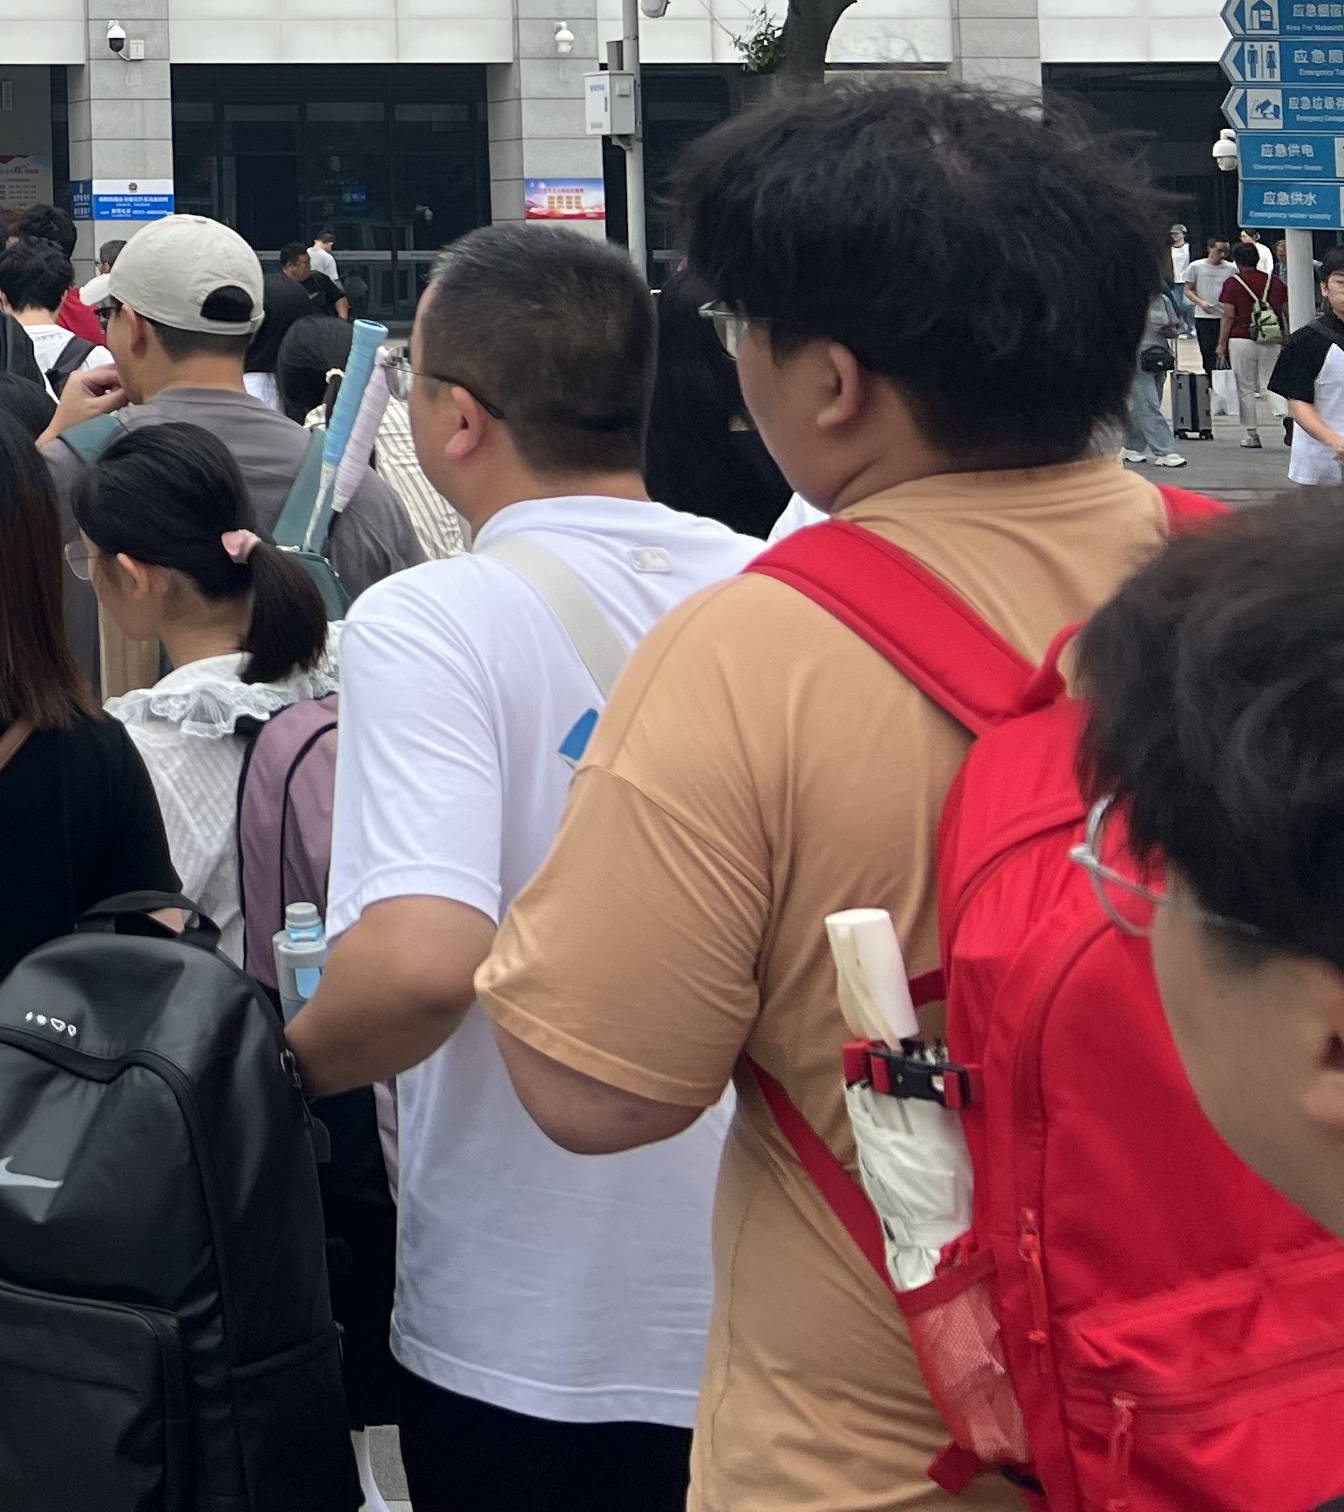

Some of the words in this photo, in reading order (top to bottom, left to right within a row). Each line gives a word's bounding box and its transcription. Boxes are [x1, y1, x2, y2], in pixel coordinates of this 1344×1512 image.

[1261, 143, 1314, 157] 应急供电
[1263, 191, 1318, 206] 应急供水
